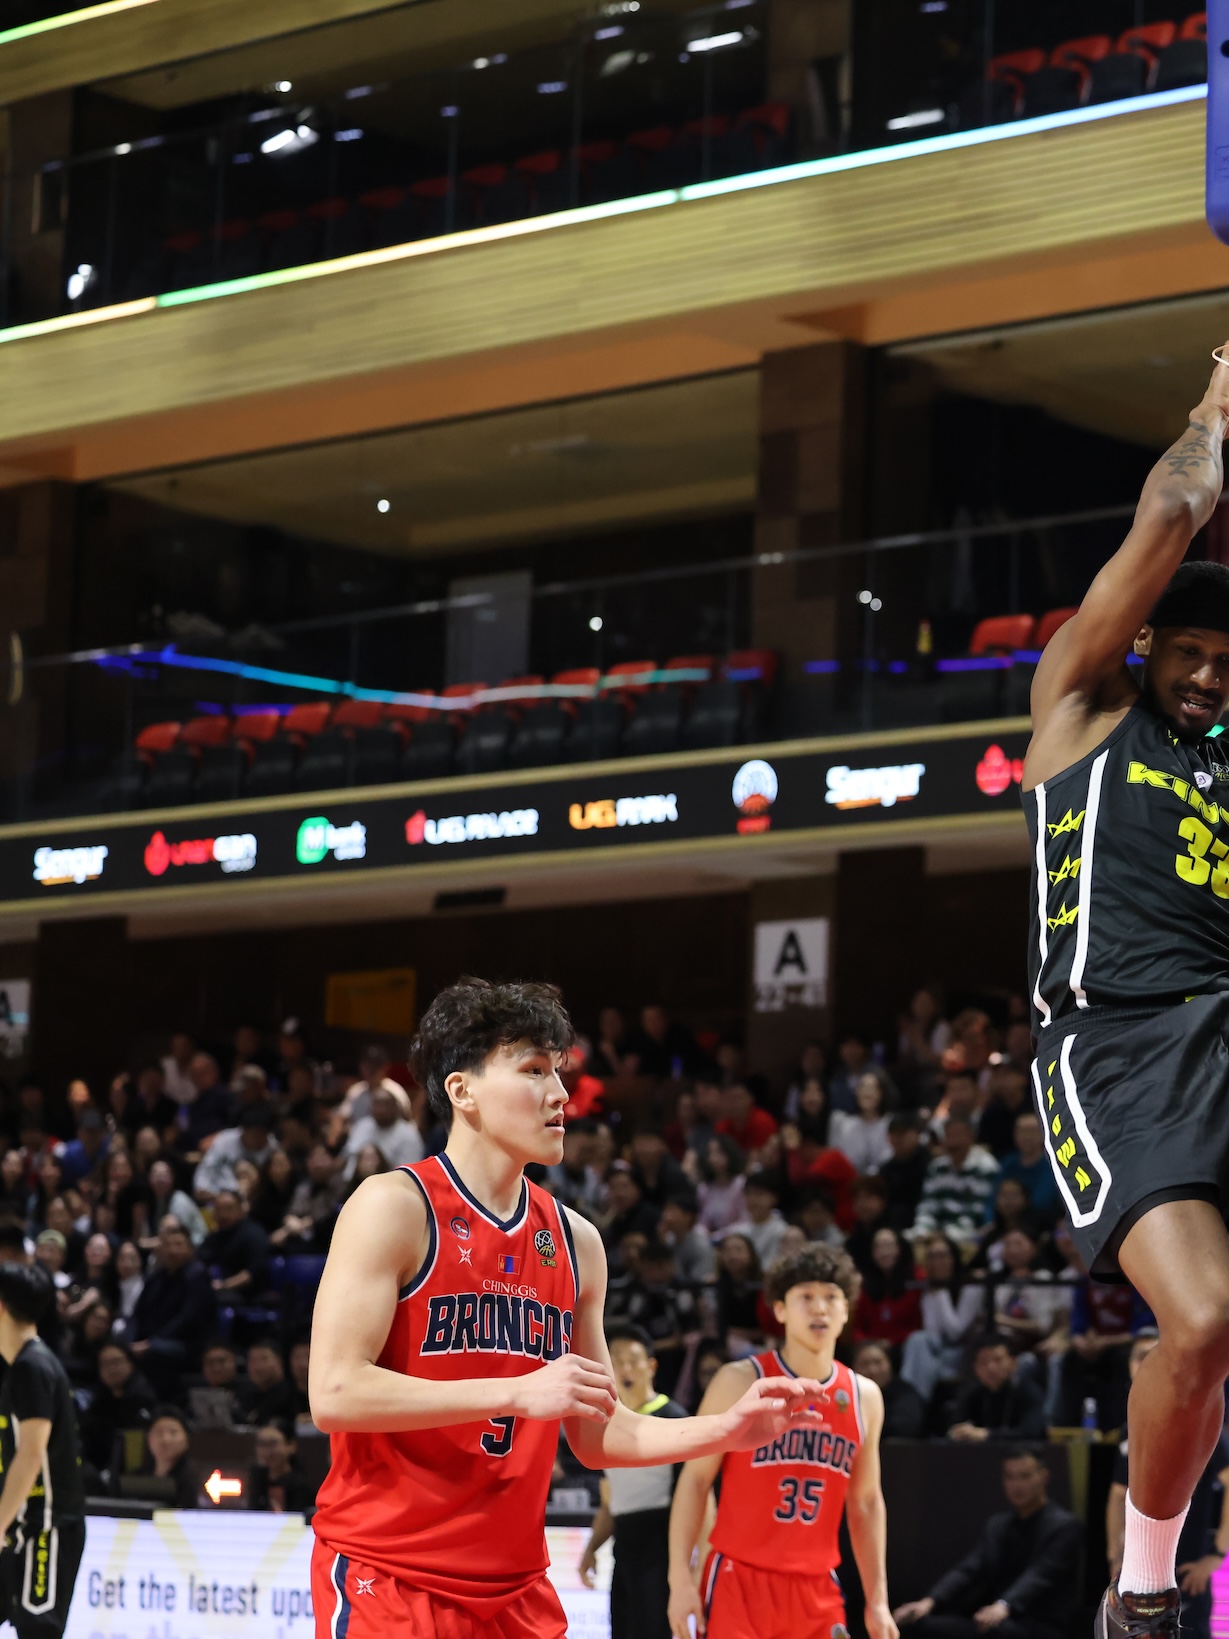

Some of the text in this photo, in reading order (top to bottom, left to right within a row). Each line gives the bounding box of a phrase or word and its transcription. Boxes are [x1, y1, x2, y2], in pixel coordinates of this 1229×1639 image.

[773, 929, 810, 977] A
[482, 1279, 538, 1299] CHINGGIS
[773, 1475, 825, 1525] 35
[88, 1570, 126, 1609] Get
[138, 1573, 177, 1612] the
[188, 1573, 259, 1617] latest
